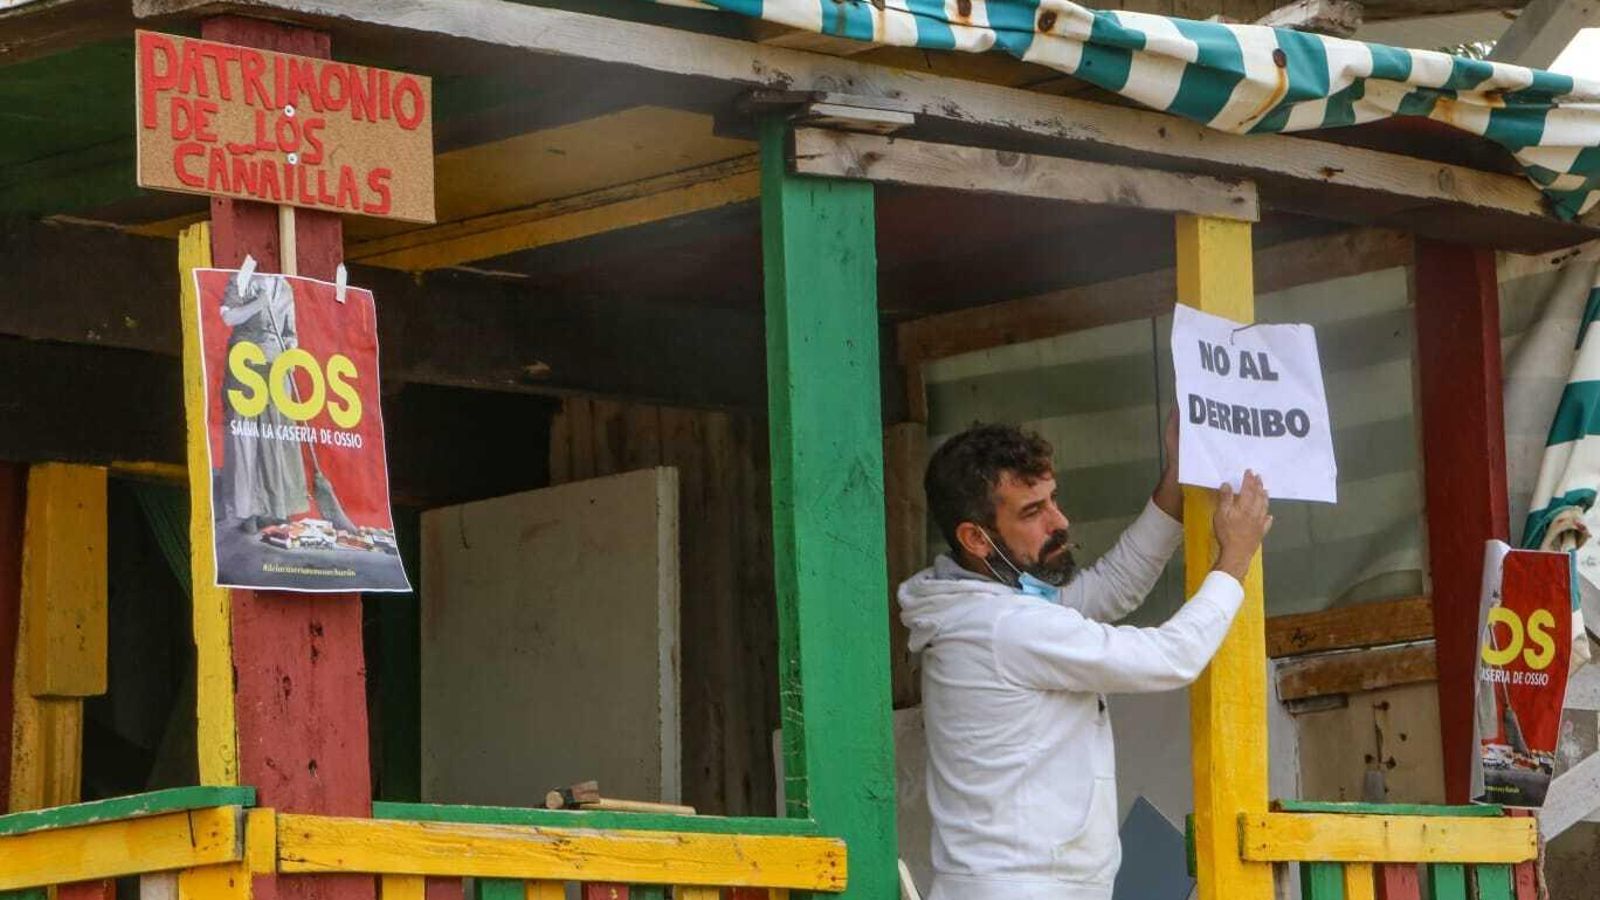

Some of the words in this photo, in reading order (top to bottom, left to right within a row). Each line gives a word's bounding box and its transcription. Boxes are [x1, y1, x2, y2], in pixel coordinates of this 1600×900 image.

[140, 33, 425, 131] PATRIMONIO
[170, 96, 219, 142] DE
[254, 110, 325, 165] LOS
[173, 142, 392, 215] CAÑAILLAS
[228, 341, 362, 429] SOS
[1198, 339, 1231, 376] NO
[1239, 350, 1279, 382] AL
[230, 419, 260, 438] SALVA
[262, 423, 275, 440] LA
[320, 428, 332, 446] DE
[333, 430, 362, 449] OSSIO
[1187, 393, 1311, 438] DERRIBO
[1481, 607, 1555, 669] OS
[1512, 671, 1523, 685] DE
[1524, 672, 1549, 686] OSSIO
